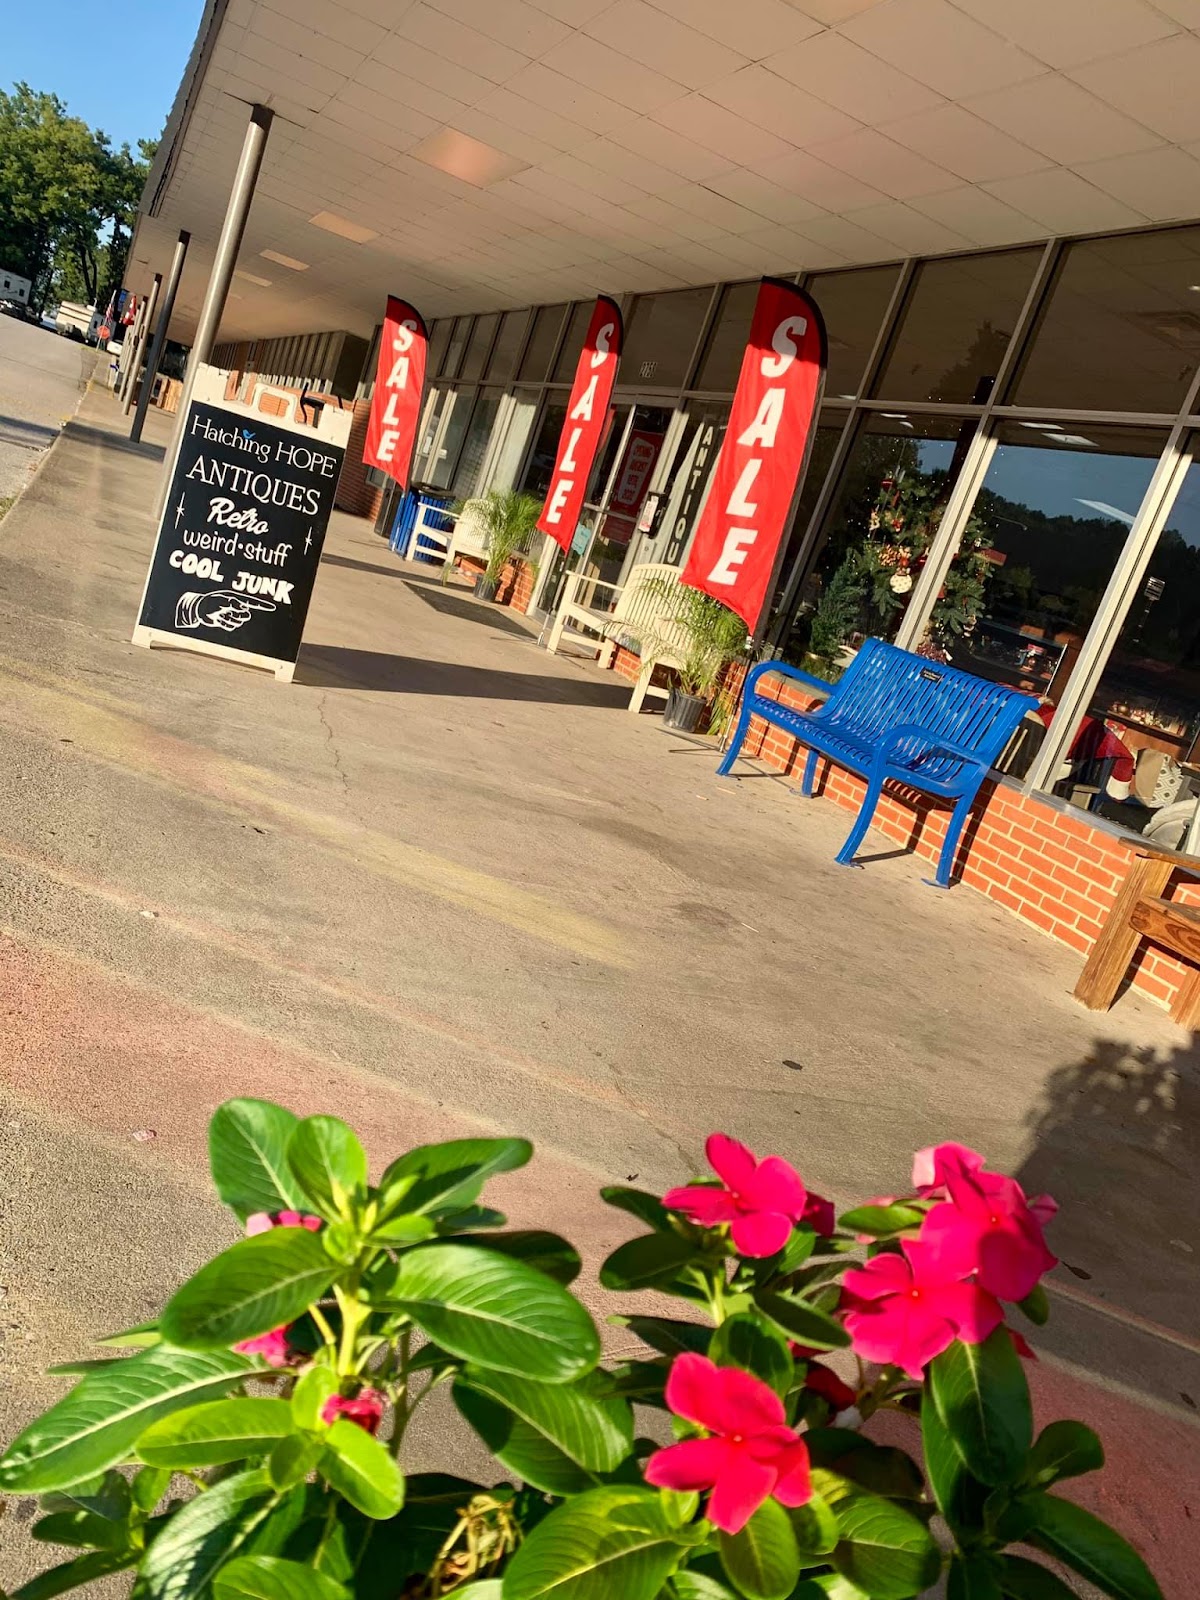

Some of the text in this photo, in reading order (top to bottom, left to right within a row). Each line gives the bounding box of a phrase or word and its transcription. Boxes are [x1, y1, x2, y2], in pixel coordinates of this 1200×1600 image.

[376, 319, 417, 462] SALE
[190, 414, 337, 479] Hatching HOPE
[546, 323, 615, 524] SALE
[707, 316, 807, 586] SALE
[185, 455, 321, 516] ANTIQUES
[207, 496, 270, 535] Retro
[169, 550, 295, 605] COOL JUNK
